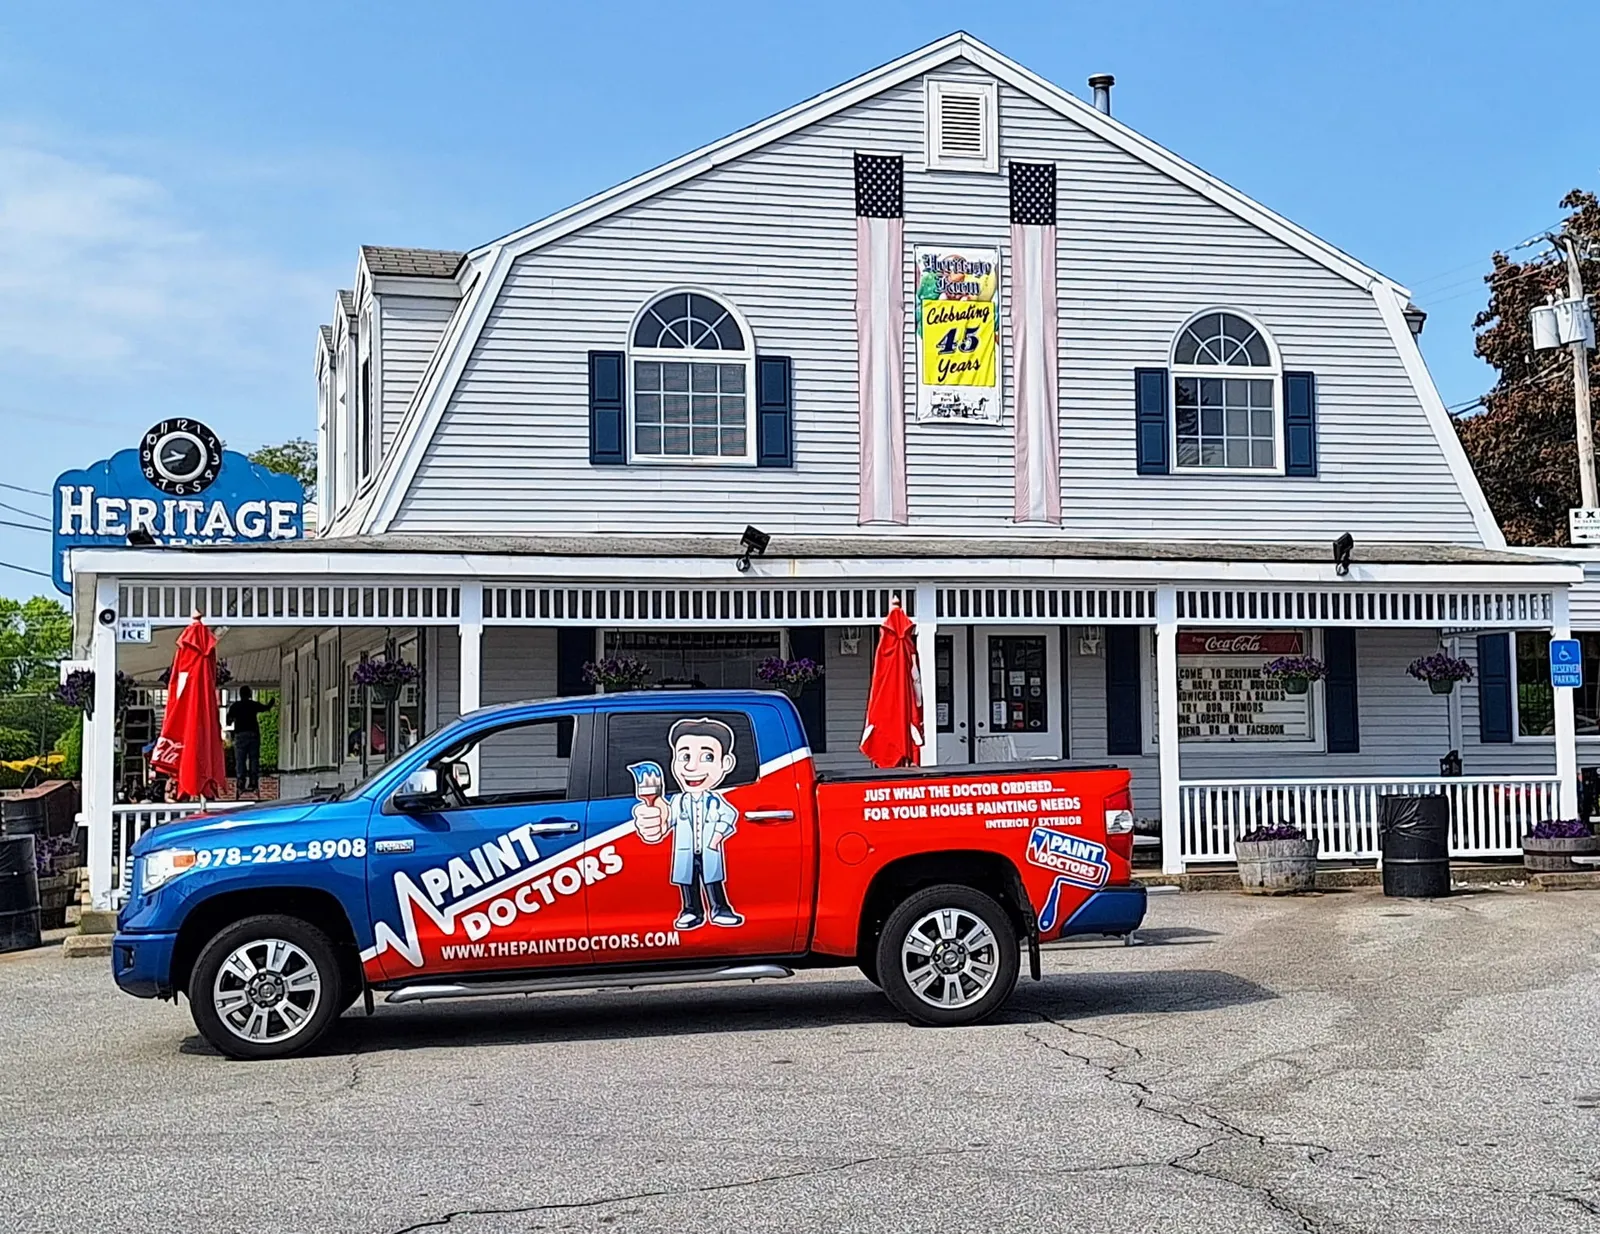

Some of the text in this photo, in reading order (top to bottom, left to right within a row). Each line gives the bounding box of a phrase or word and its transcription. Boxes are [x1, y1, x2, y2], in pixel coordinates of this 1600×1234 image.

[926, 306, 990, 326] Celebrating
[936, 325, 980, 356] 45
[937, 358, 981, 383] Years
[161, 422, 168, 434] 11
[177, 419, 188, 431] 12
[197, 424, 201, 434] 1
[208, 437, 215, 448] 2
[143, 450, 151, 461] 9
[211, 453, 220, 465] 3
[145, 467, 154, 478] 8
[204, 469, 214, 480] 4
[159, 479, 168, 490] 7
[175, 484, 184, 494] 6
[192, 481, 201, 492] 5
[59, 485, 298, 540] HERITAGE
[1574, 511, 1600, 519] EX
[122, 630, 145, 640] ICE
[1205, 634, 1262, 652] Coca-Cola
[1178, 668, 1203, 680] COME
[1211, 668, 1221, 679] TO
[1225, 668, 1262, 679] HERITAGE
[1553, 674, 1579, 685] PARKING
[1192, 680, 1213, 690] HAVE
[1219, 680, 1243, 690] GREAT
[1220, 691, 1241, 701] SUBS
[1255, 690, 1286, 701] SALADS
[1182, 702, 1264, 713] TRY OUR FAMOUS
[1196, 714, 1230, 724] LOBSTER
[1234, 713, 1254, 724] ROLL
[1178, 724, 1285, 736] RIEND US ON FACEBOOK
[863, 788, 892, 802] JUST
[893, 786, 926, 800] WHAT
[927, 784, 951, 799] THE
[952, 782, 1000, 797] DOCTOR
[864, 797, 1081, 821] FOR YOUR HOUSE PAINTING NEEDS
[985, 818, 1030, 829] INTERIOR
[1037, 815, 1082, 827] EXTERIOR
[197, 838, 367, 868] 978-226-8908
[1050, 834, 1102, 862] PAINT
[420, 823, 541, 907] PAINT
[1038, 851, 1096, 877] DOCTORS
[461, 845, 624, 942] DOCTORS
[441, 931, 681, 961] WWW.THEPAINTDOCTORS.COM
